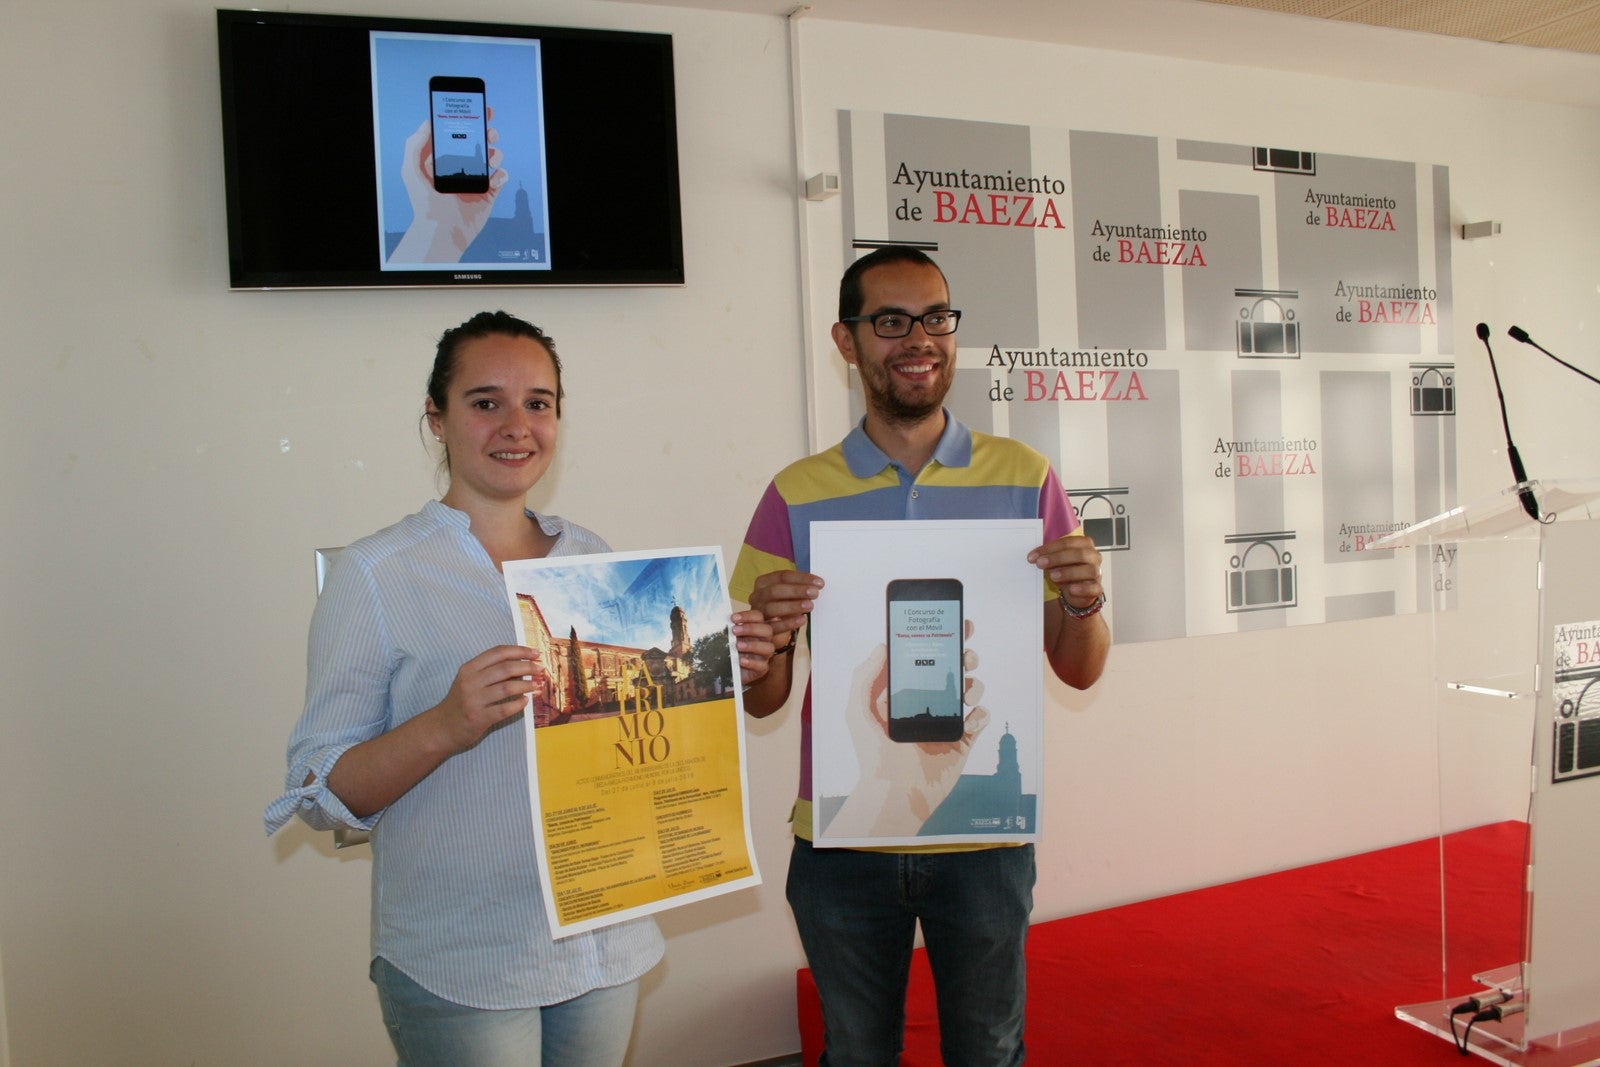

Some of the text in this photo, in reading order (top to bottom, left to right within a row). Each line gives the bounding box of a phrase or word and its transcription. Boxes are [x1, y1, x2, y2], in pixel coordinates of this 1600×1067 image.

[893, 162, 1065, 195] Ayuntamiento
[895, 191, 1065, 229] de BAEZA
[1305, 188, 1396, 210] Ayuntamiento
[1306, 206, 1396, 232] de BAEZA
[1091, 220, 1207, 243] Ayuntamiento
[1092, 240, 1207, 267] de BAEZA
[1335, 280, 1437, 302] Ayuntamiento
[1335, 301, 1436, 325] de BAEZA
[986, 345, 1148, 373] Ayuntamiento
[988, 370, 1148, 402] de BAEZA
[1214, 437, 1317, 458] Ayuntamiento
[1215, 453, 1316, 478] de BAEZA
[1339, 521, 1411, 538] Ayuntamiento
[1339, 541, 1351, 553] de
[1434, 574, 1452, 591] de
[1556, 651, 1571, 666] de
[618, 709, 664, 742] MO
[613, 734, 670, 769] NIO
